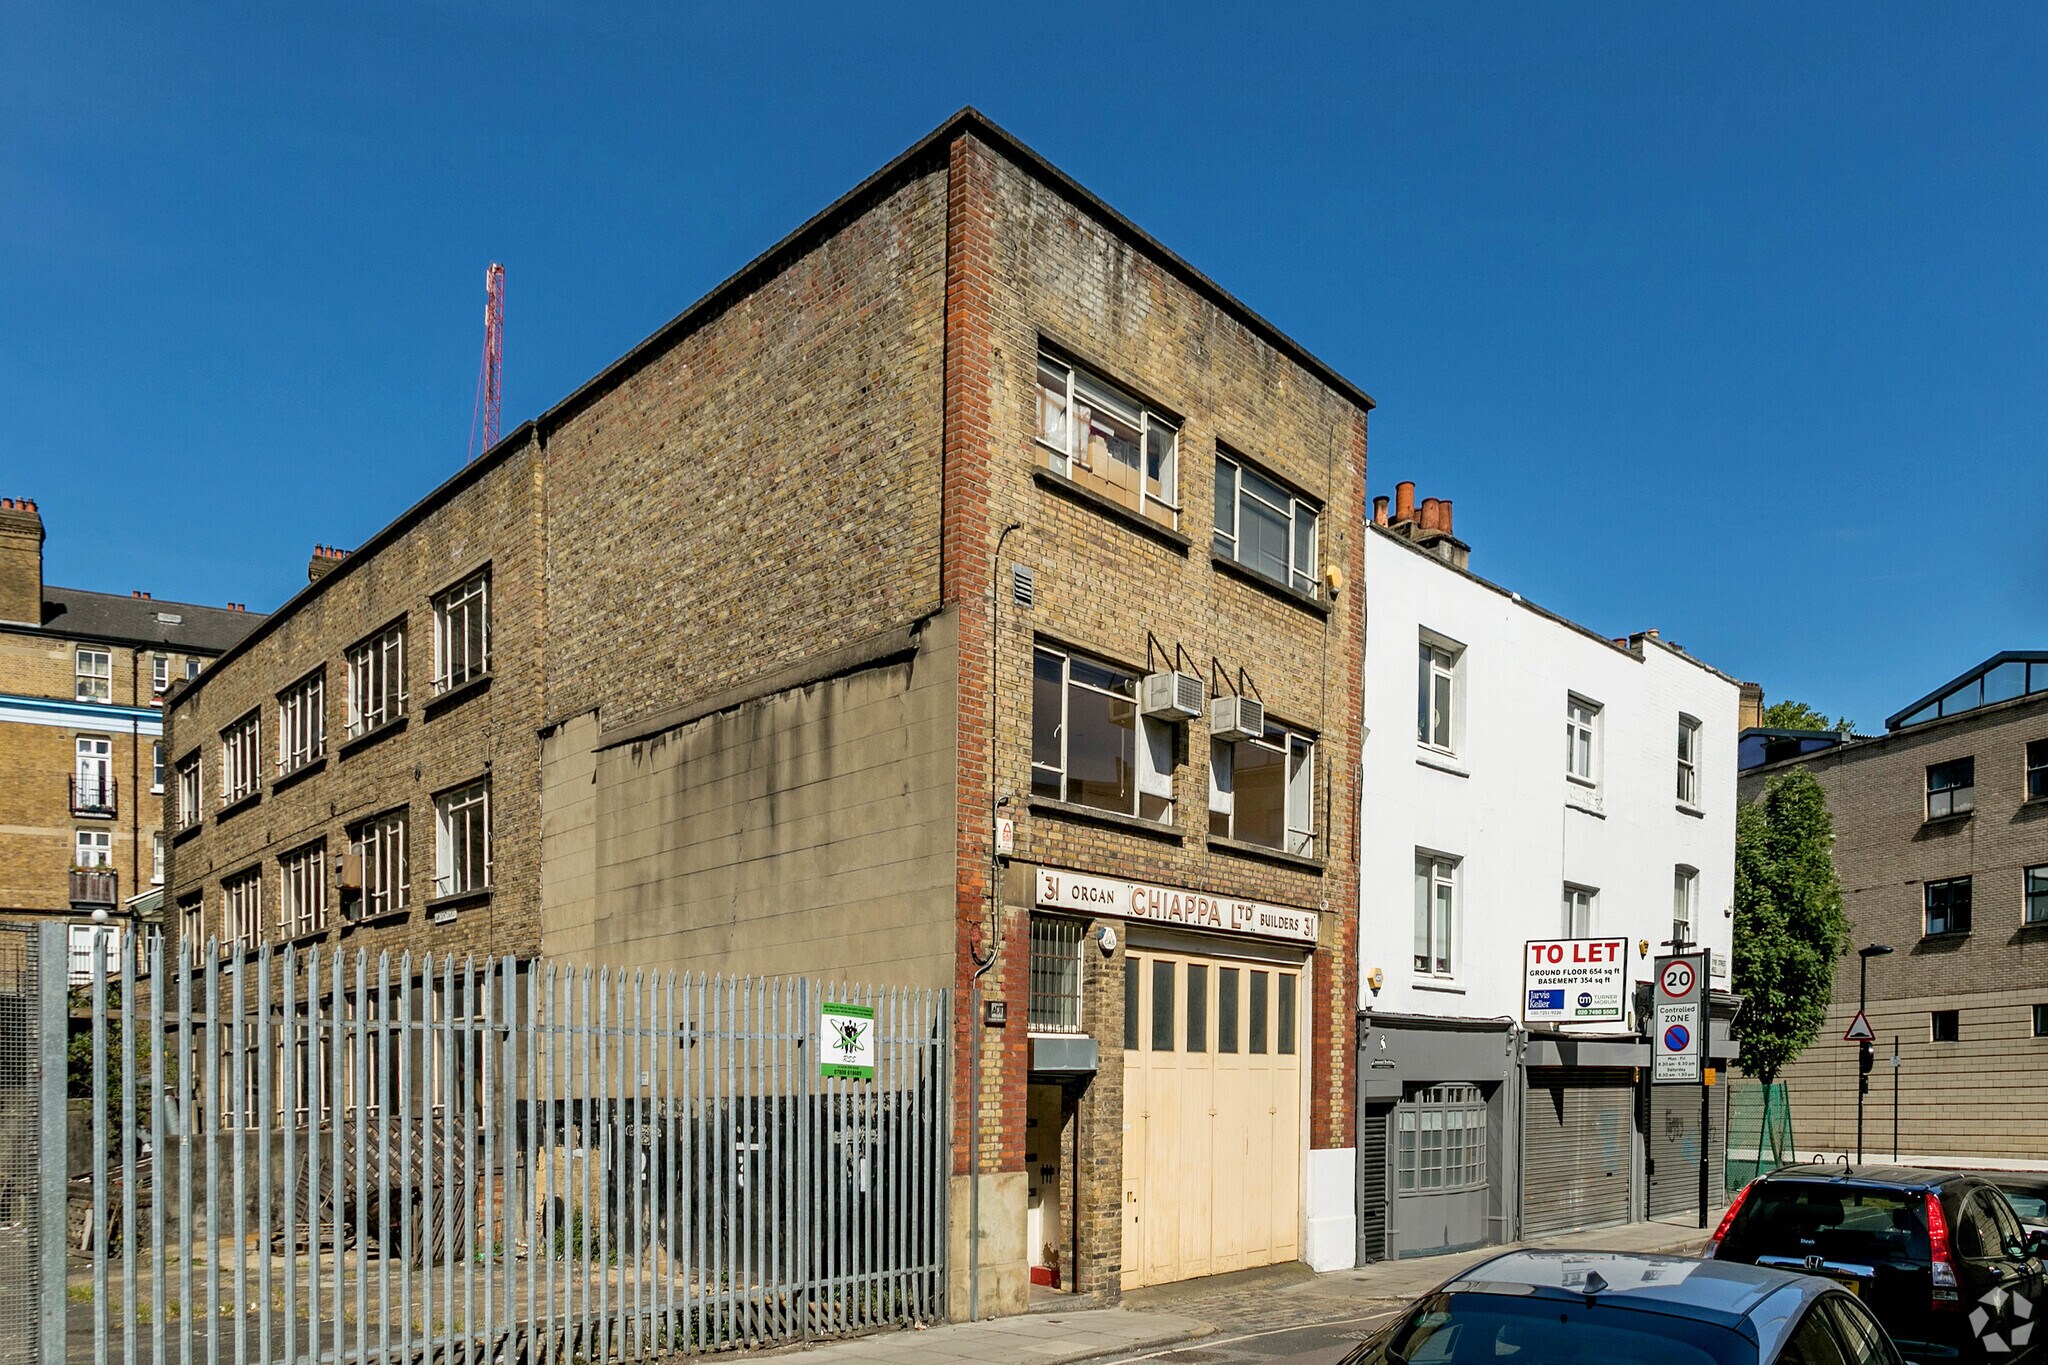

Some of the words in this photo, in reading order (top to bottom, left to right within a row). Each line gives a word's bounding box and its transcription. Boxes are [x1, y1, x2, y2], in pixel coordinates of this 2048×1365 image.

[1044, 876, 1059, 901] 31
[1071, 885, 1114, 904] ORGAN
[1131, 888, 1221, 927] CHIAPPA
[1231, 904, 1253, 930] LTD
[1260, 913, 1299, 931] BUILDERS
[1303, 917, 1314, 937] 31
[1531, 944, 1564, 964] TO
[1573, 943, 1620, 963] LET
[1538, 977, 1578, 985] BASEMENT
[1595, 977, 1603, 985] sq
[1666, 971, 1691, 987] 20
[1530, 991, 1550, 1000] Jarvis
[1529, 1000, 1550, 1008] Keller
[1660, 1006, 1695, 1014] Controlled
[1665, 1014, 1690, 1023] ZONE
[843, 1055, 856, 1063] RSS
